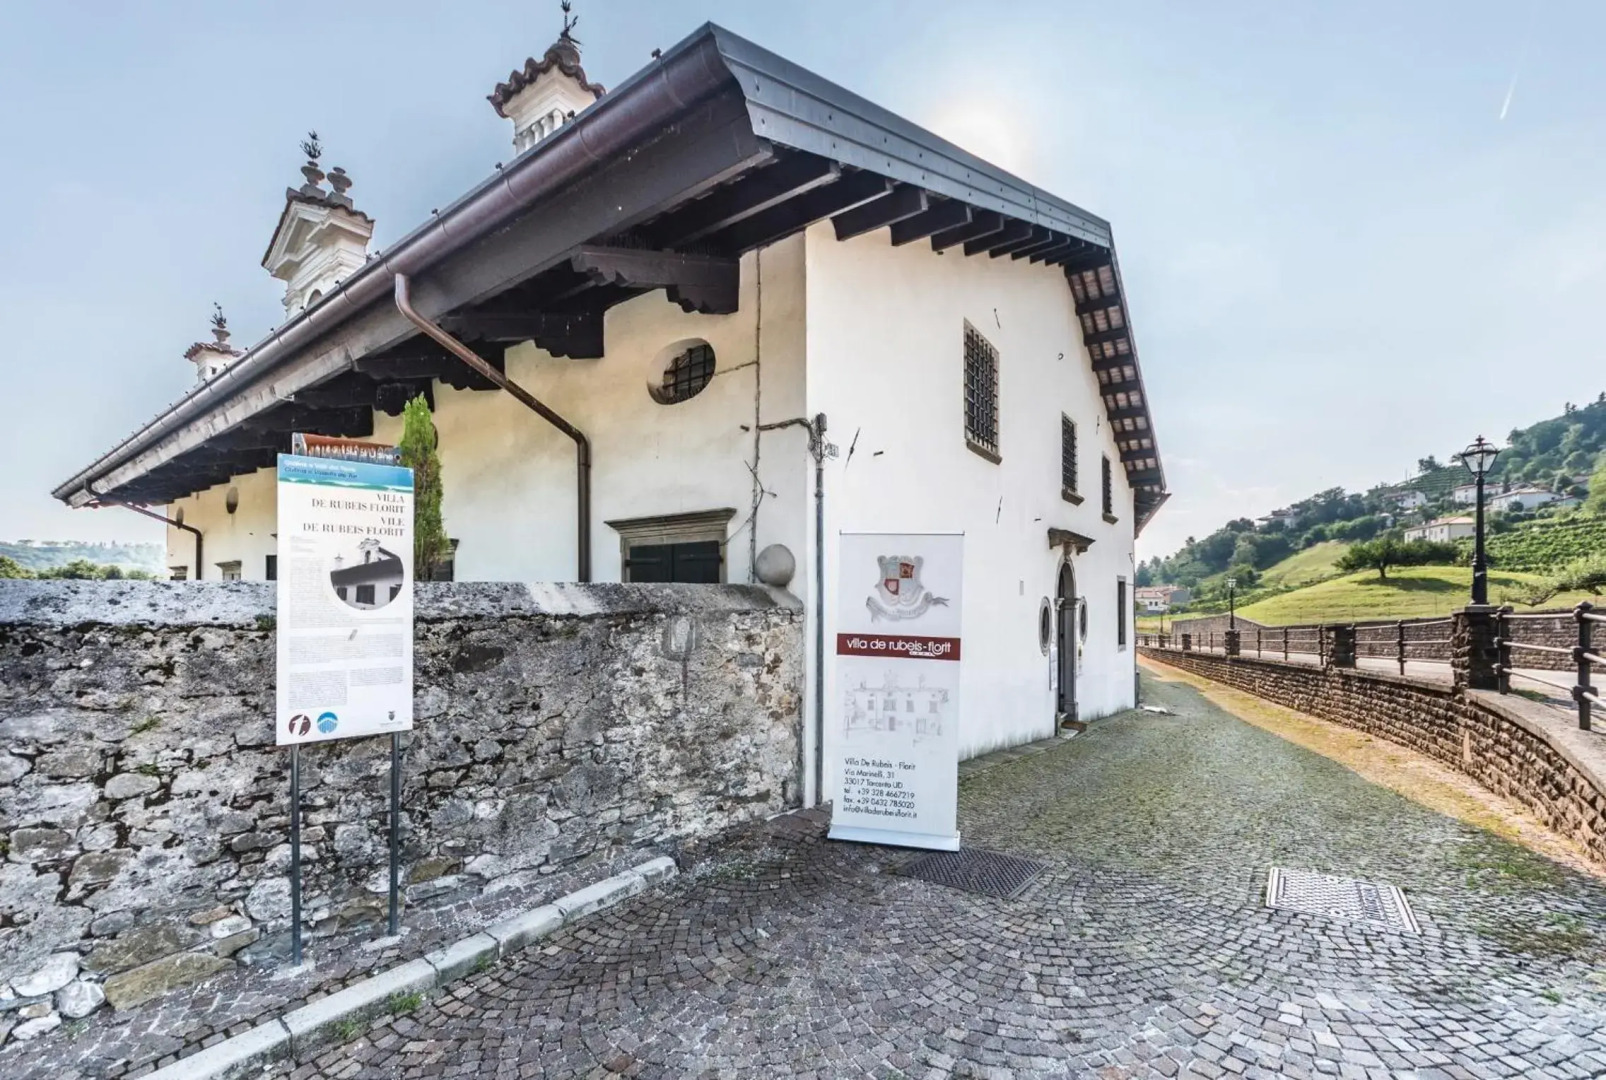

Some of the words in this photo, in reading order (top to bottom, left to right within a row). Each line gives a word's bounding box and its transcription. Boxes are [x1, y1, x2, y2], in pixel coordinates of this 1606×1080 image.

[377, 493, 405, 503] VILLA
[311, 498, 326, 508] DE
[329, 500, 367, 511] RUBEIS
[369, 503, 406, 514] FLORIT
[381, 516, 405, 526] VILE
[303, 523, 318, 532] DE
[322, 524, 364, 534] RUBEIS
[366, 526, 406, 537] FLORIT
[847, 638, 867, 649] villa
[870, 639, 886, 649] de
[844, 757, 859, 766] Villa
[860, 758, 870, 767] De
[871, 759, 893, 769] Rubeis
[898, 761, 916, 770] Florit
[886, 771, 895, 779] 31
[844, 777, 865, 786] 33017
[892, 781, 904, 789] UD
[871, 788, 884, 797] 328
